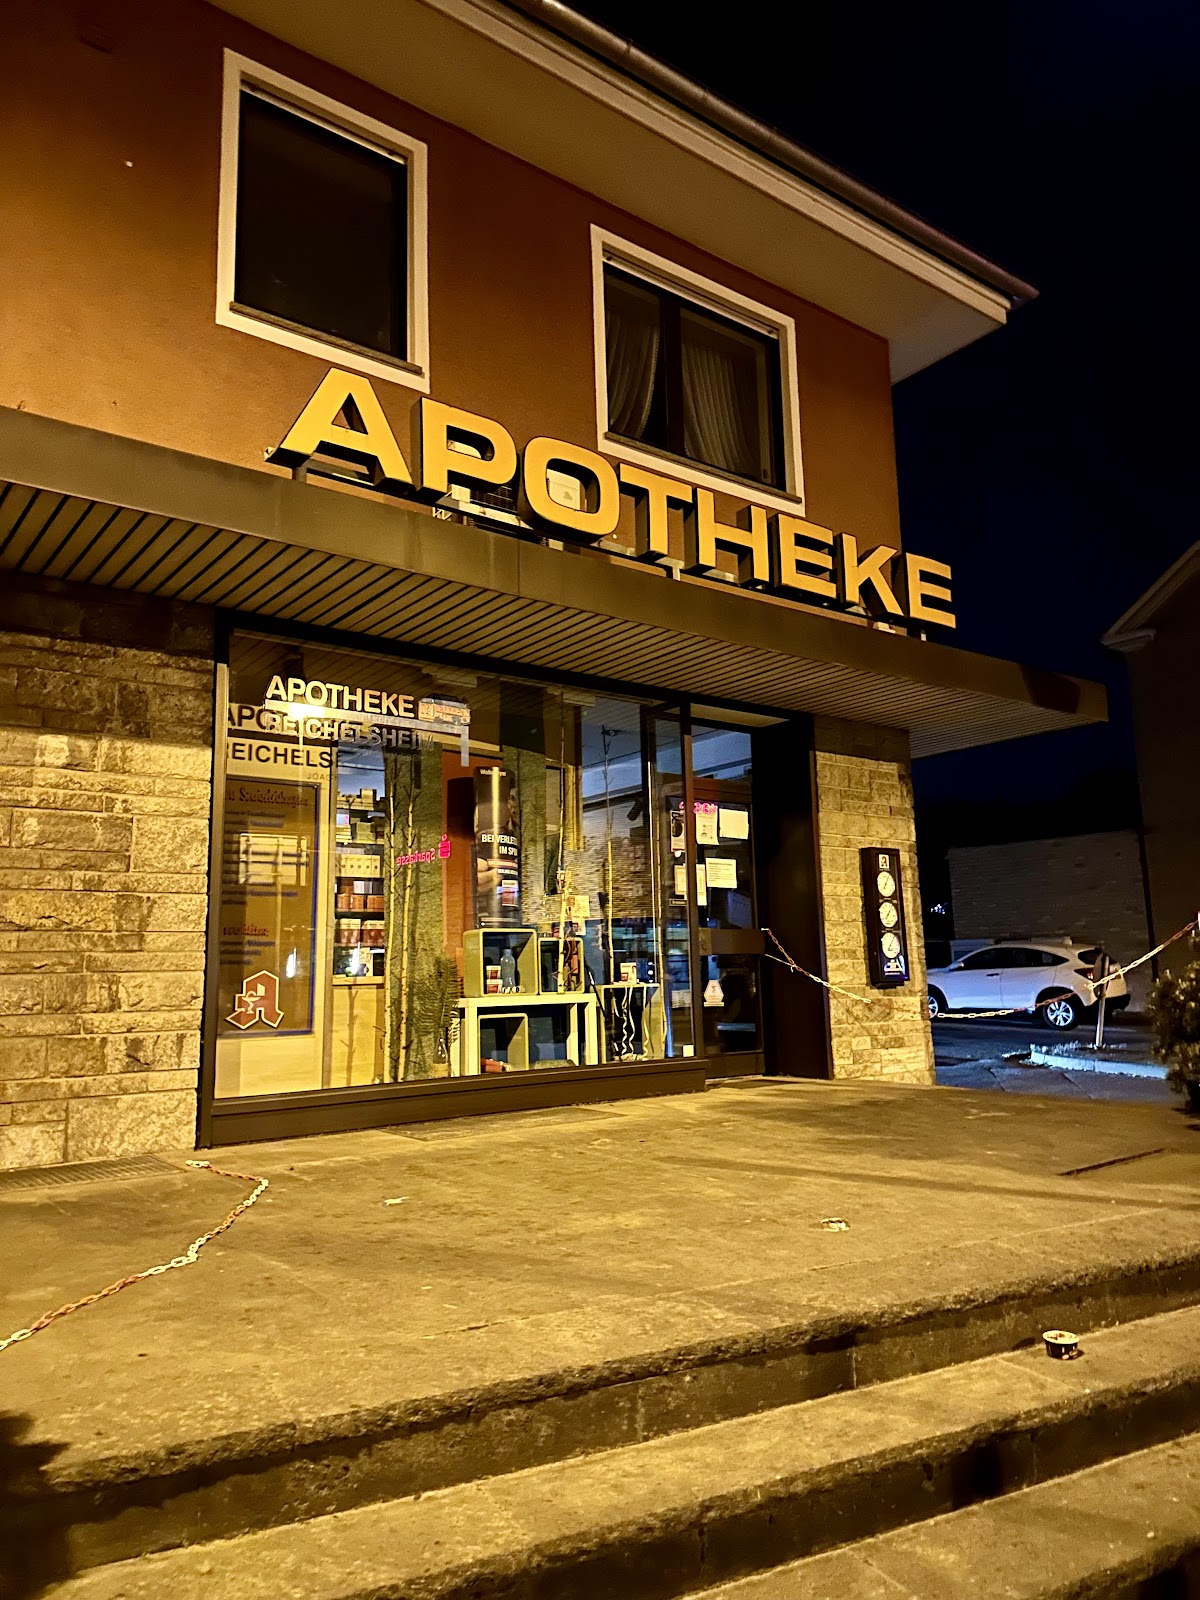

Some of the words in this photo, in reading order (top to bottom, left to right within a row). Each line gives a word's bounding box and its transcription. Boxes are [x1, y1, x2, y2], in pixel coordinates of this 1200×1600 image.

[272, 366, 957, 629] APOTHEKE
[265, 675, 415, 718] APOTHEKE
[264, 713, 435, 751] REICHELSHEIM
[227, 742, 334, 768] EICHELS
